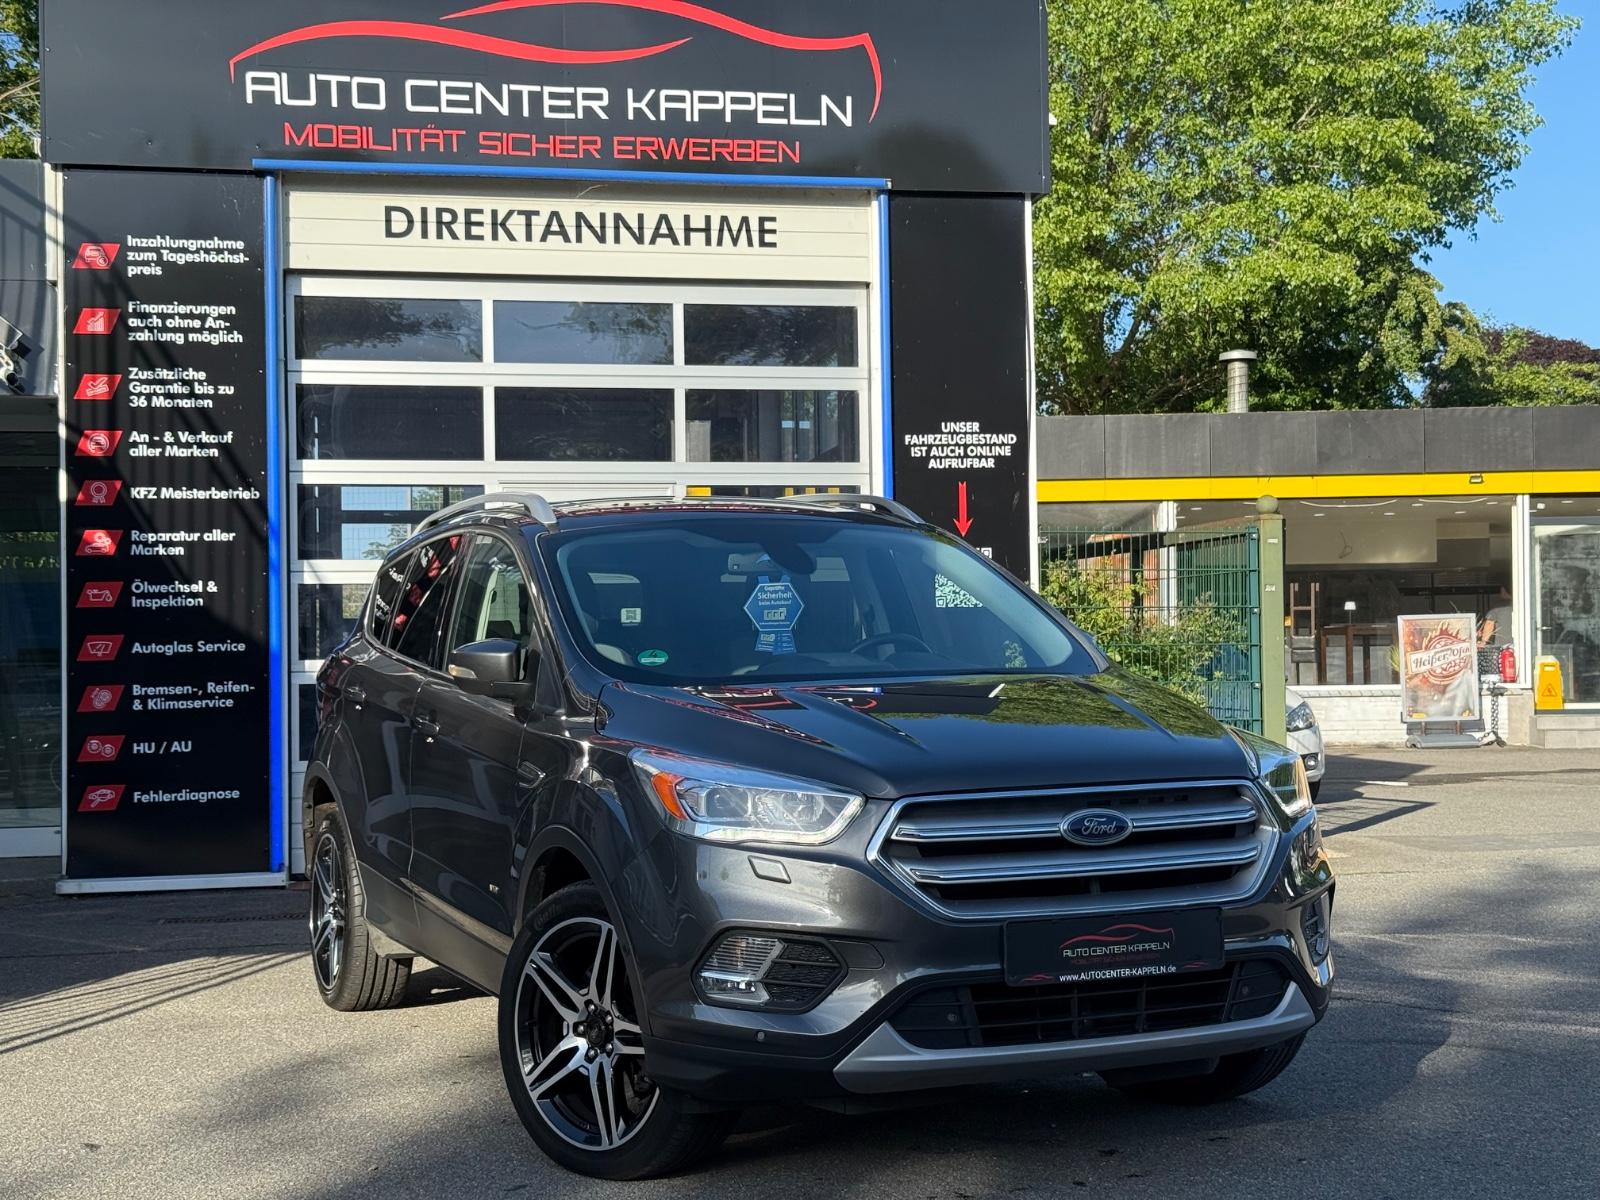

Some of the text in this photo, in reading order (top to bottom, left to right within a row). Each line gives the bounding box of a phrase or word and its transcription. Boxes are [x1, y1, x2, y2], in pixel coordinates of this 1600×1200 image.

[246, 71, 852, 126] AUTO CENTER KAPPELN
[284, 122, 800, 162] MOBILITÄT SICHER ERWERBEN
[385, 204, 779, 248] DIREKTANNAHME
[127, 235, 244, 251] Inzahlungnahme
[127, 249, 249, 264] zum Tageshöchst-
[128, 263, 162, 277] preis
[128, 301, 235, 317] Finanzierungen
[128, 316, 230, 328] auch ohne An-
[128, 330, 243, 345] zahlung möglich
[128, 368, 206, 380] Zusätzliche
[129, 382, 234, 394] Garantie bis zu
[129, 396, 212, 408] 36 Monaten
[942, 422, 979, 432] UNSER
[129, 431, 149, 442] An
[163, 431, 174, 442] &
[178, 431, 233, 443] Verkauf
[905, 434, 1016, 445] FAHRZEUGBESTAND
[129, 444, 218, 457] aller Marken
[911, 446, 1011, 457] IST AUCH ONLINE
[928, 458, 995, 468] AUFRUFBAR
[131, 487, 259, 499] KFZ Meisterbetrieb
[131, 529, 236, 545] Reparatur aller
[132, 544, 184, 555] Marken
[131, 579, 217, 593] Ölwechsel &
[132, 595, 203, 609] Inspektion
[132, 640, 245, 655] Autoglas Service
[133, 681, 255, 697] Bremsen-, Reifen-
[133, 697, 233, 710] & Klimaservice
[133, 741, 191, 754] HU / AU
[134, 789, 240, 802] Fehlerdiagnose
[1082, 818, 1116, 835] Ford
[1063, 942, 1170, 957] AUTO CENTER KAPPELN
[1059, 965, 1176, 982] www.AUTOCENTER-KAPPELN.de
